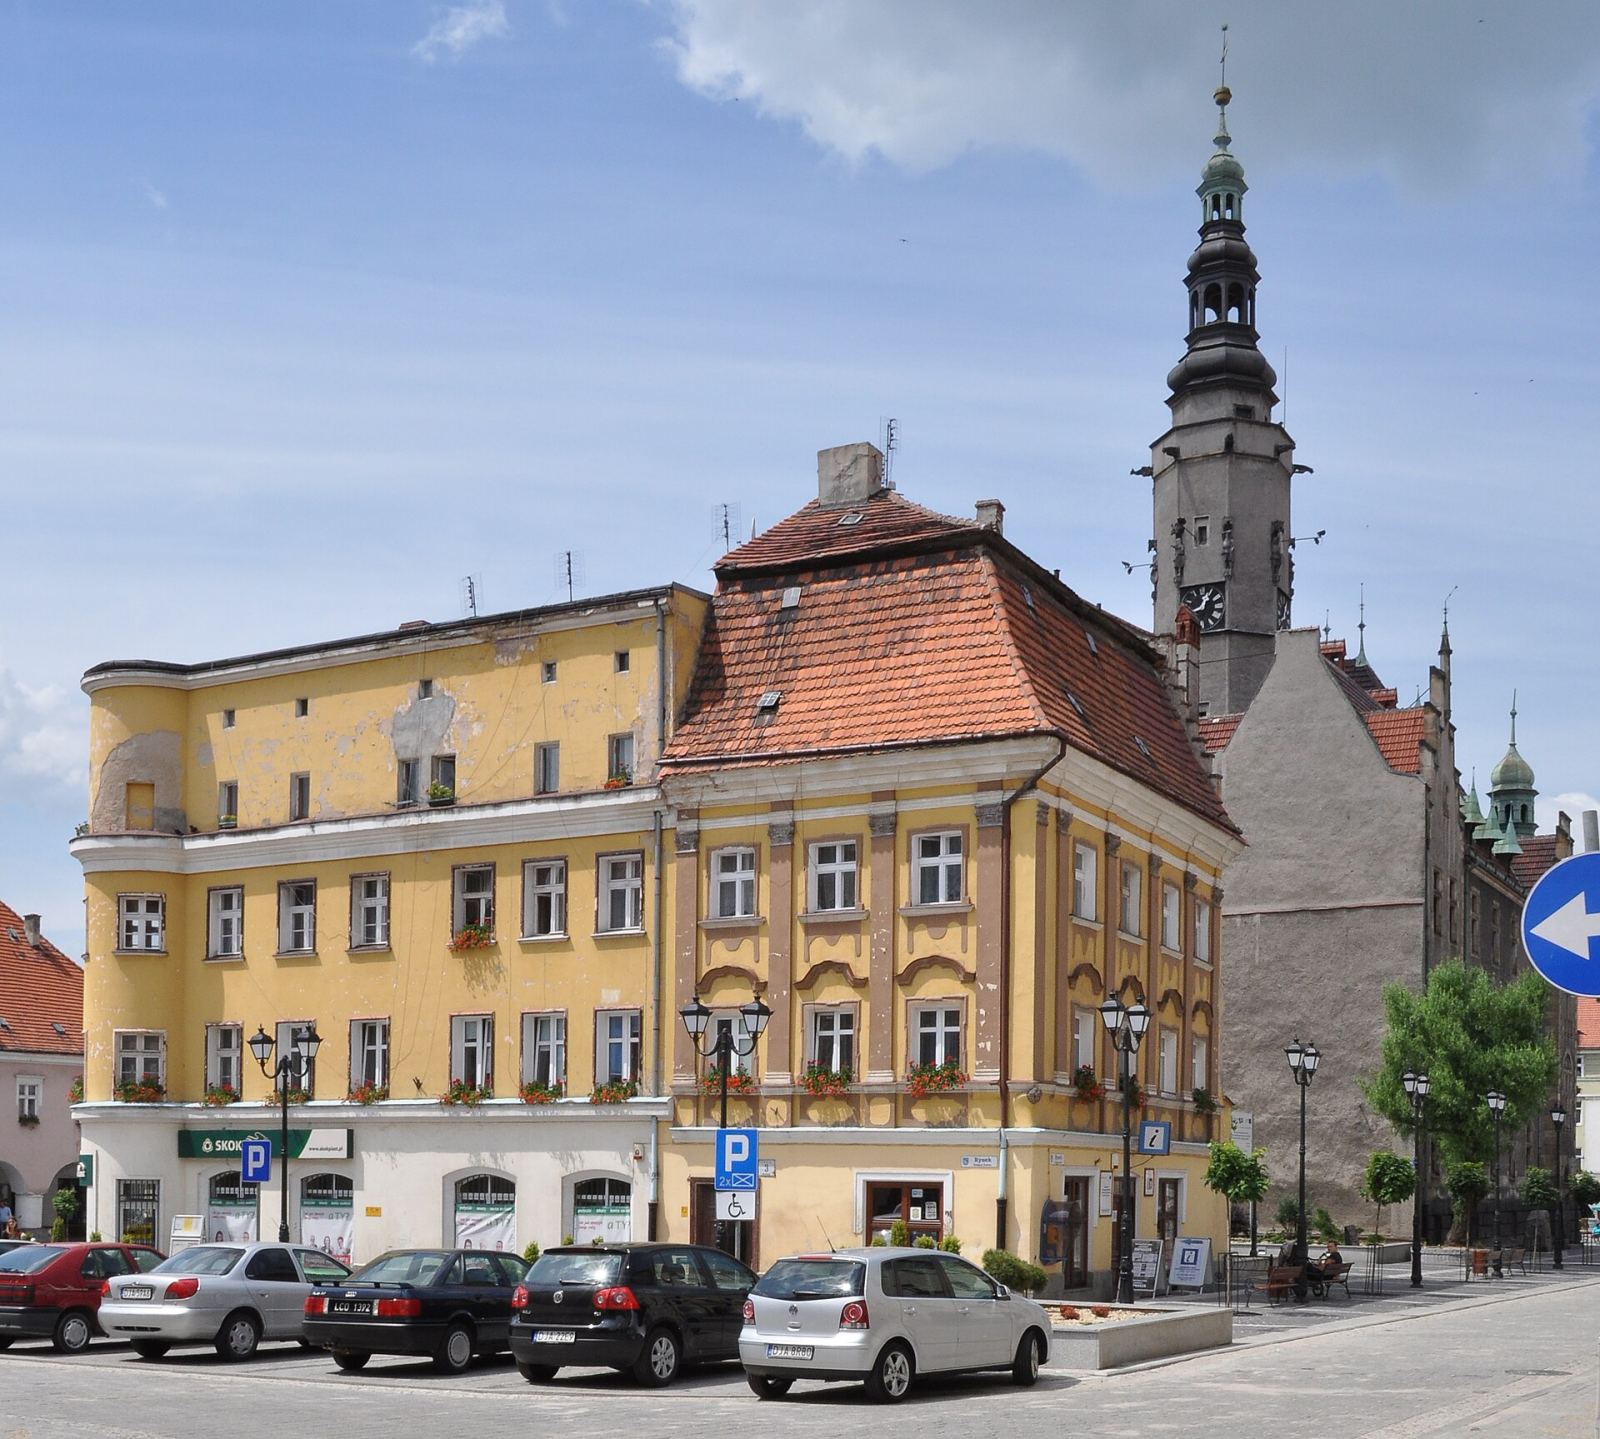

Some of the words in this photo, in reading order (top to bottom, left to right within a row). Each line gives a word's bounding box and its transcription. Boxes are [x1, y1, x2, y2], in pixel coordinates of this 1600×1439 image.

[215, 1140, 243, 1151] SKOK
[725, 1135, 749, 1172] P
[248, 1146, 264, 1176] P
[719, 1176, 731, 1186] 2x
[773, 1345, 789, 1356] DJA
